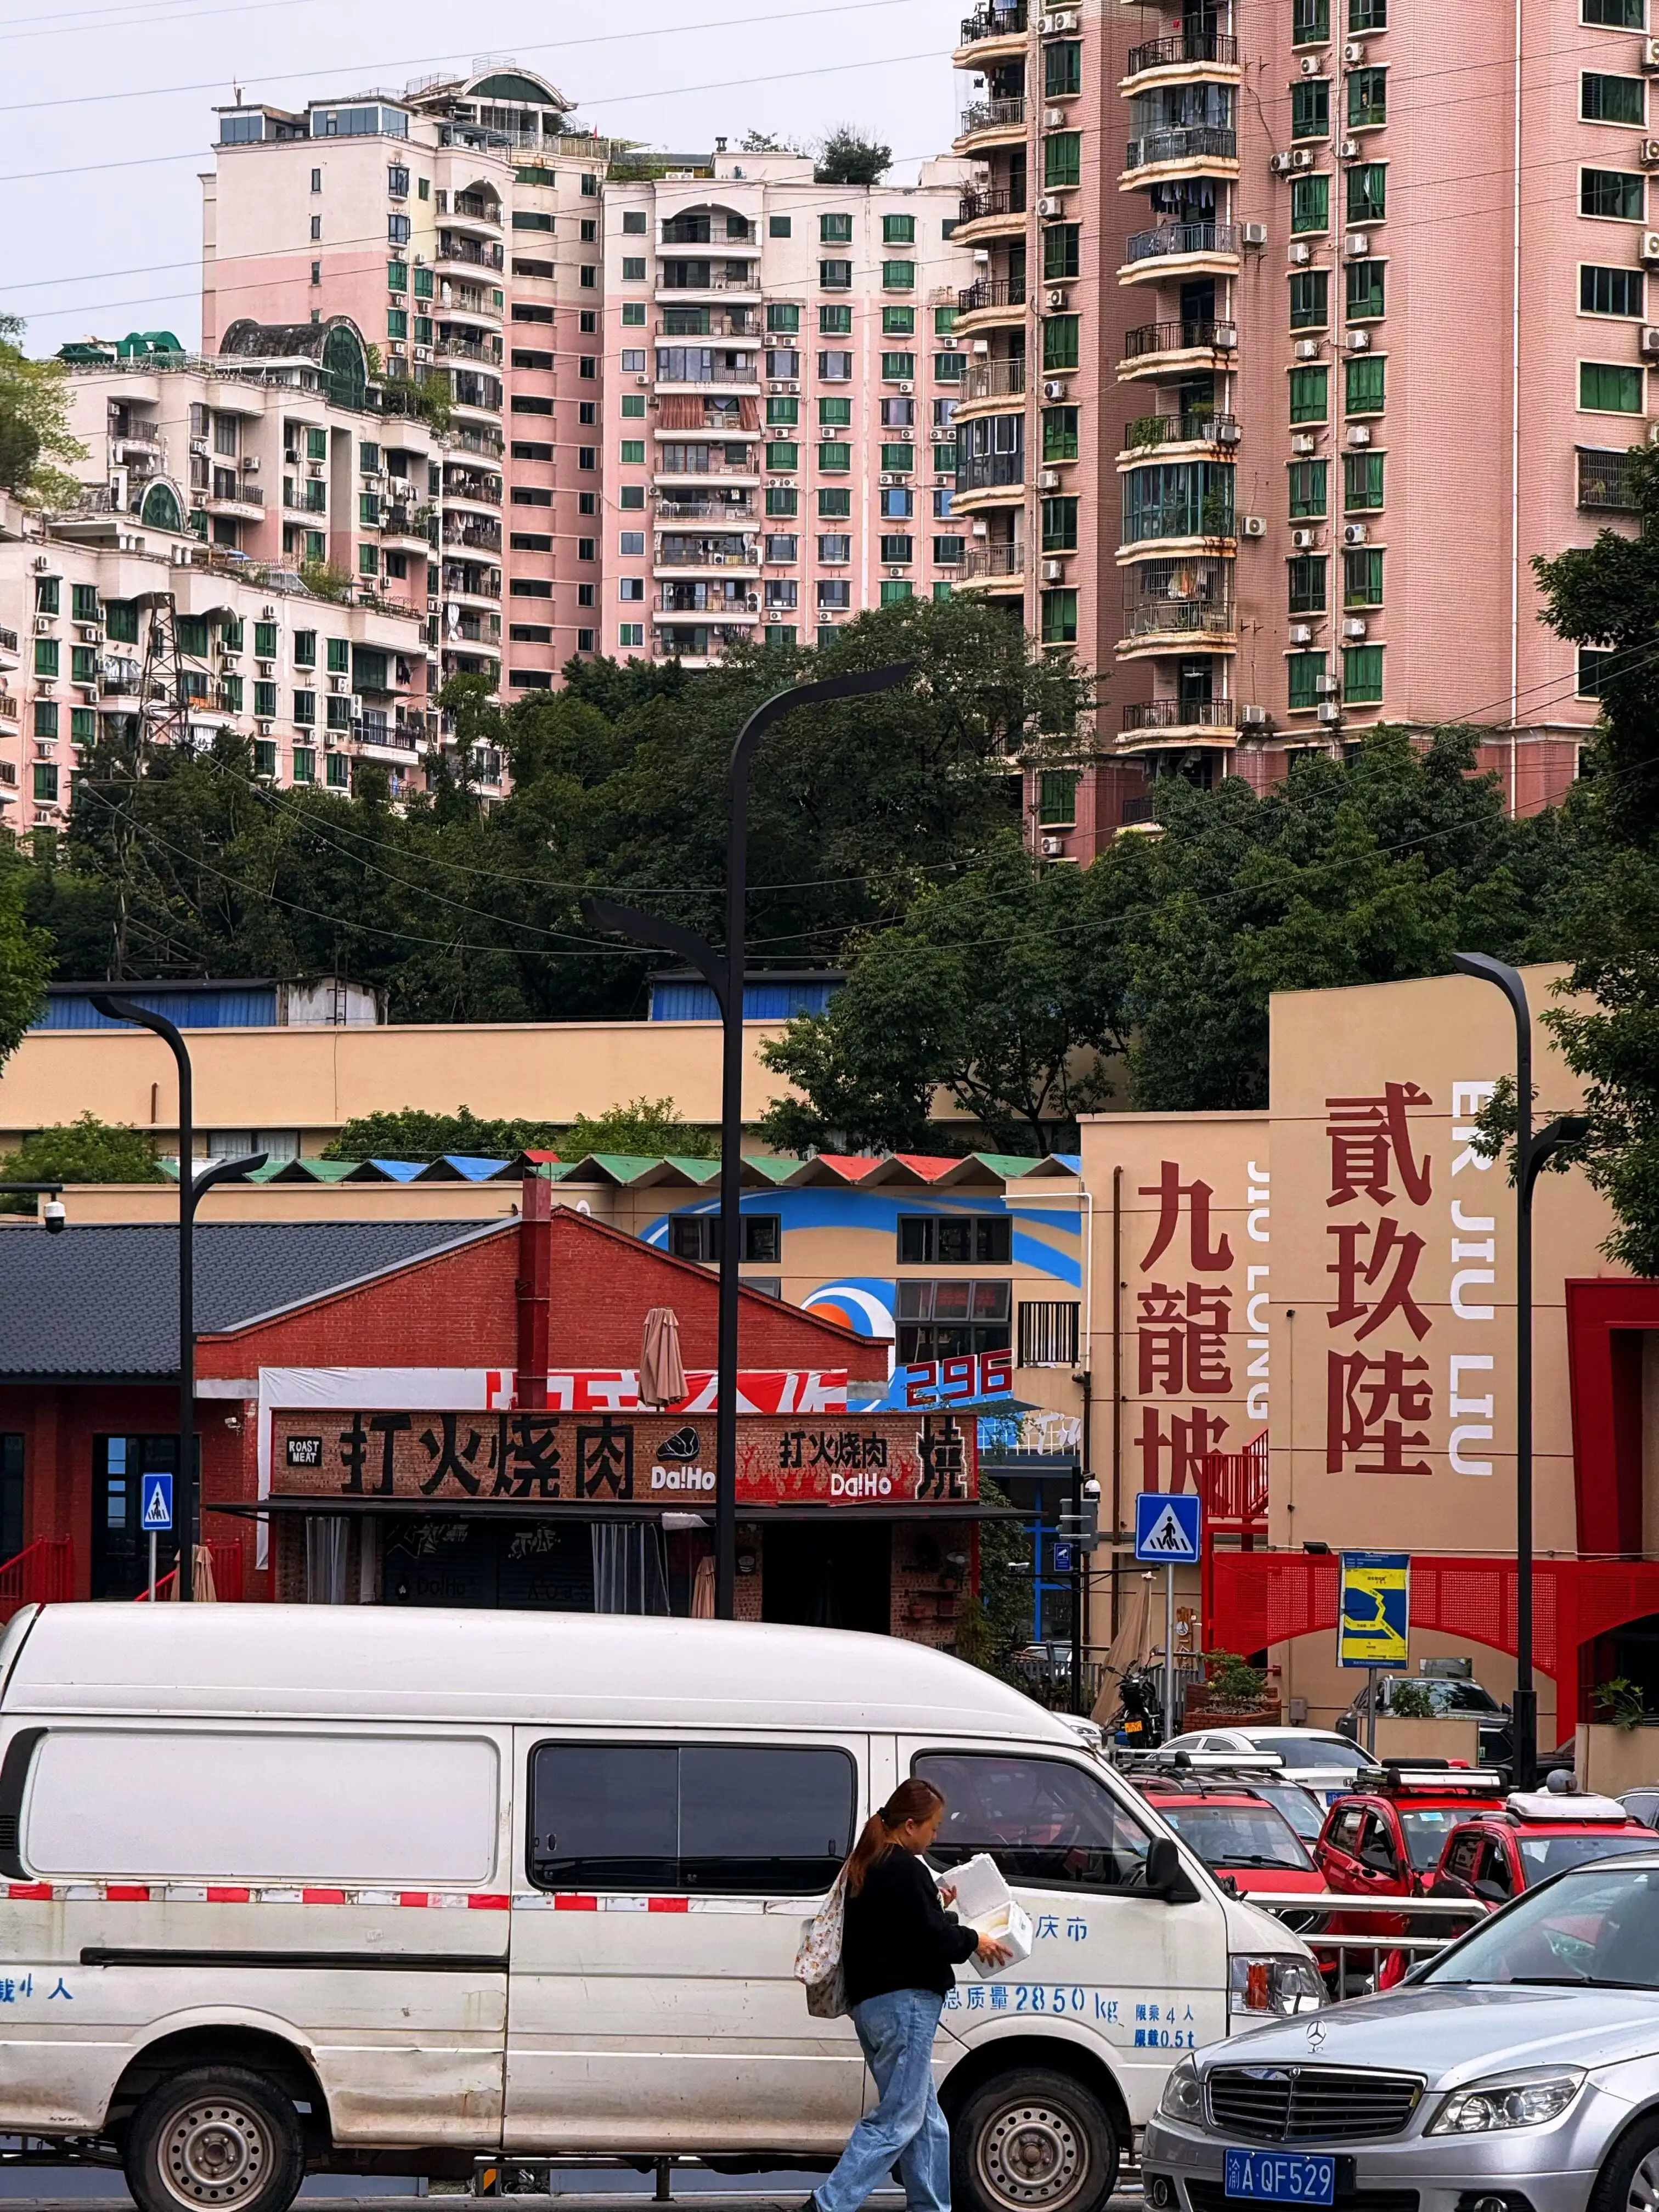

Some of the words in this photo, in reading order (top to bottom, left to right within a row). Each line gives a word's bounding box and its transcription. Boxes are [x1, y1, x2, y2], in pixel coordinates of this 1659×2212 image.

[1452, 1081, 1496, 1177] ER
[1247, 1160, 1270, 1242] JIU
[1451, 1199, 1495, 1321] JIU
[906, 1348, 1014, 1408] 296
[1247, 1265, 1270, 1420] LONG
[290, 1441, 319, 1452] ROAST
[780, 1431, 887, 1469] 打火烧肉
[1448, 1354, 1494, 1476] LIU
[293, 1453, 317, 1464] MEAT
[339, 1413, 634, 1500] 打火烧肉
[1025, 1912, 1087, 1942] 庆市
